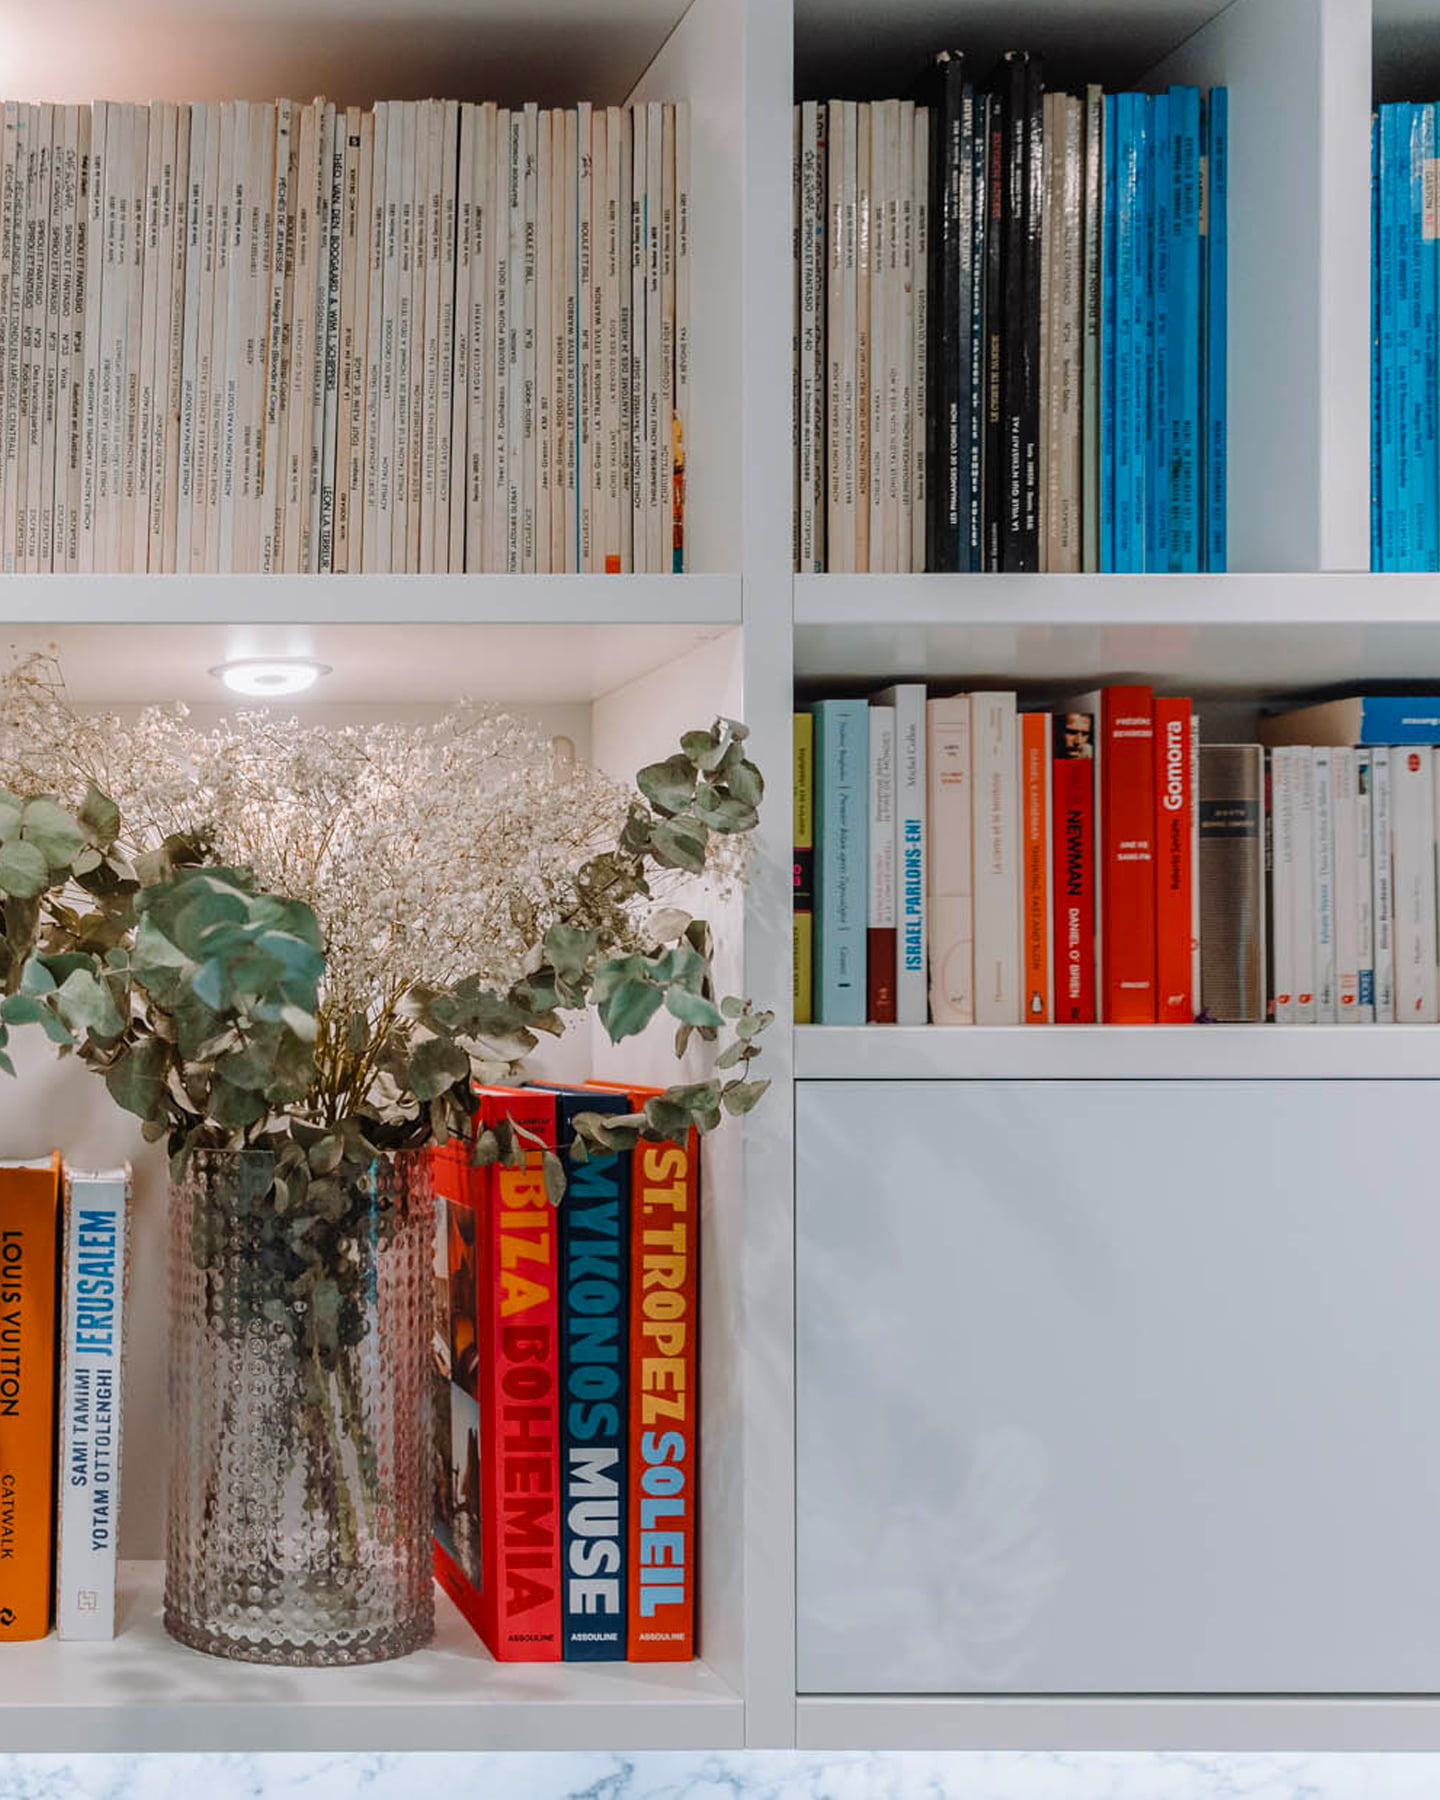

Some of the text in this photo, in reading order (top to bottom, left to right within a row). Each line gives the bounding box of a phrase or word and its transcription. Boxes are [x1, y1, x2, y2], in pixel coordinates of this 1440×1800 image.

[3, 201, 12, 212] DE
[332, 183, 341, 205] VAN
[37, 219, 46, 251] SPIROU
[277, 215, 285, 227] DE
[332, 208, 341, 229] DEN
[805, 217, 813, 252] SPIROU
[2, 213, 11, 260] JEUNESSE
[64, 224, 73, 258] SPIROU
[76, 221, 86, 255] SPIROU
[276, 228, 284, 273] JEUNESSE
[286, 246, 294, 257] ET
[526, 221, 534, 251] BOULE
[582, 221, 590, 251] BOULE
[36, 252, 44, 262] ET
[64, 259, 72, 270] ET
[76, 256, 85, 268] ET
[330, 234, 340, 293] BOOGAARD
[526, 252, 534, 263] ET
[582, 253, 589, 263] ET
[805, 253, 813, 266] ET
[35, 262, 44, 306] FANTASIO
[62, 273, 72, 317] FANTASIO
[74, 269, 84, 313] FANTASIO
[804, 267, 813, 312] FANTASIO
[329, 310, 338, 331] WIM
[10, 349, 19, 361] EN
[74, 330, 82, 353] N°34
[326, 343, 338, 391] SCHIPPERS
[1012, 416, 1020, 433] PAS
[950, 455, 957, 465] DE
[322, 514, 331, 527] LA
[1012, 520, 1019, 531] LA
[321, 529, 331, 569] TERREUR
[1030, 748, 1039, 782] DANIEL
[1163, 722, 1182, 812] Gomorra
[1066, 809, 1082, 896] NEWMAN
[1170, 855, 1180, 891] Roberto
[905, 819, 922, 971] ISRAEL, PARLONS-EN!
[1068, 907, 1080, 948] DANIEL
[1069, 964, 1080, 998] BRIEN
[76, 1210, 117, 1357] JERUSALEM
[0, 1231, 23, 1560] LOUIS VUITTON CATWALK
[567, 1151, 620, 1614] MYKONOS MUSE
[640, 1148, 687, 1618] ST. TROPEZ SOLEIL
[72, 1368, 90, 1487] SAMI TAMIMI
[92, 1369, 112, 1551] YOTAM OTTOLENGHI
[502, 1323, 555, 1618] BOHEMIA
[508, 1633, 554, 1642] ASSOULINE
[570, 1632, 618, 1642] ASSOULINE
[638, 1632, 686, 1641] ASSOULINE
